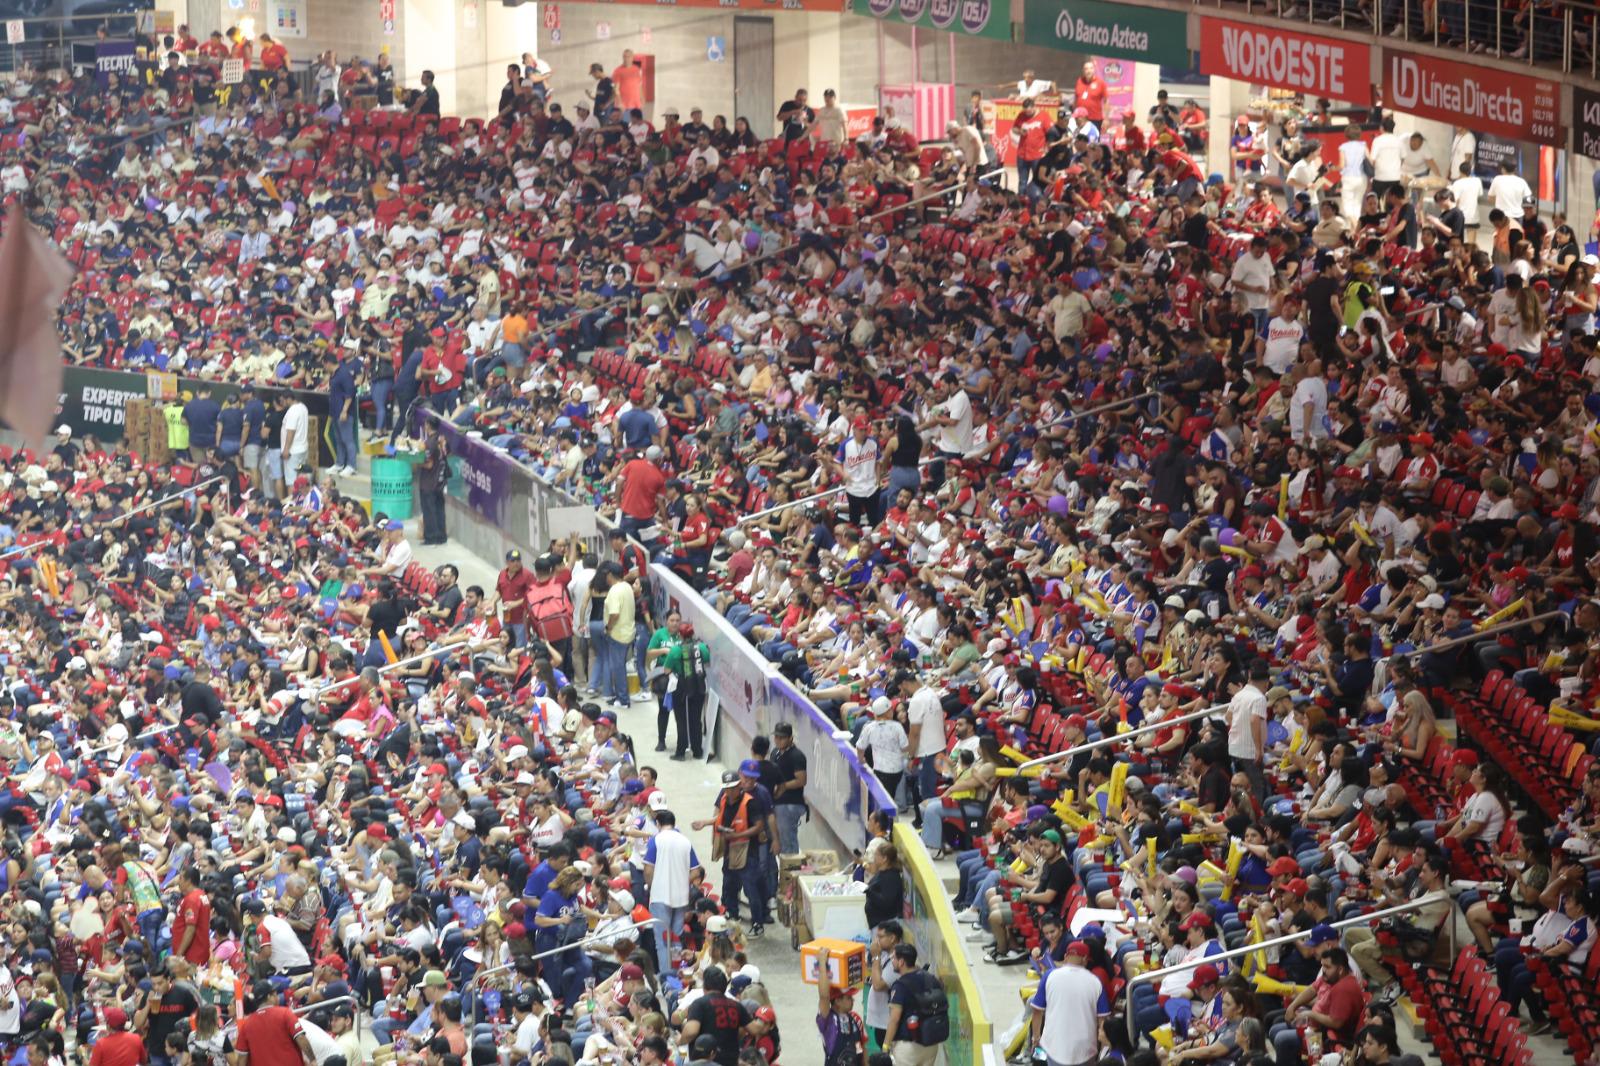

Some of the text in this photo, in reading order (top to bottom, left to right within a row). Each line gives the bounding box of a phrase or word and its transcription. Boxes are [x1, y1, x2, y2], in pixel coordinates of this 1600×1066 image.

[962, 0, 987, 22] 105.1
[1075, 18, 1148, 51] Banco Azteca
[97, 54, 136, 72] TECATE
[1222, 26, 1344, 94] NOROESTE
[1421, 69, 1461, 112] Línea
[1463, 78, 1523, 126] Directa
[83, 405, 126, 425] TIPO D
